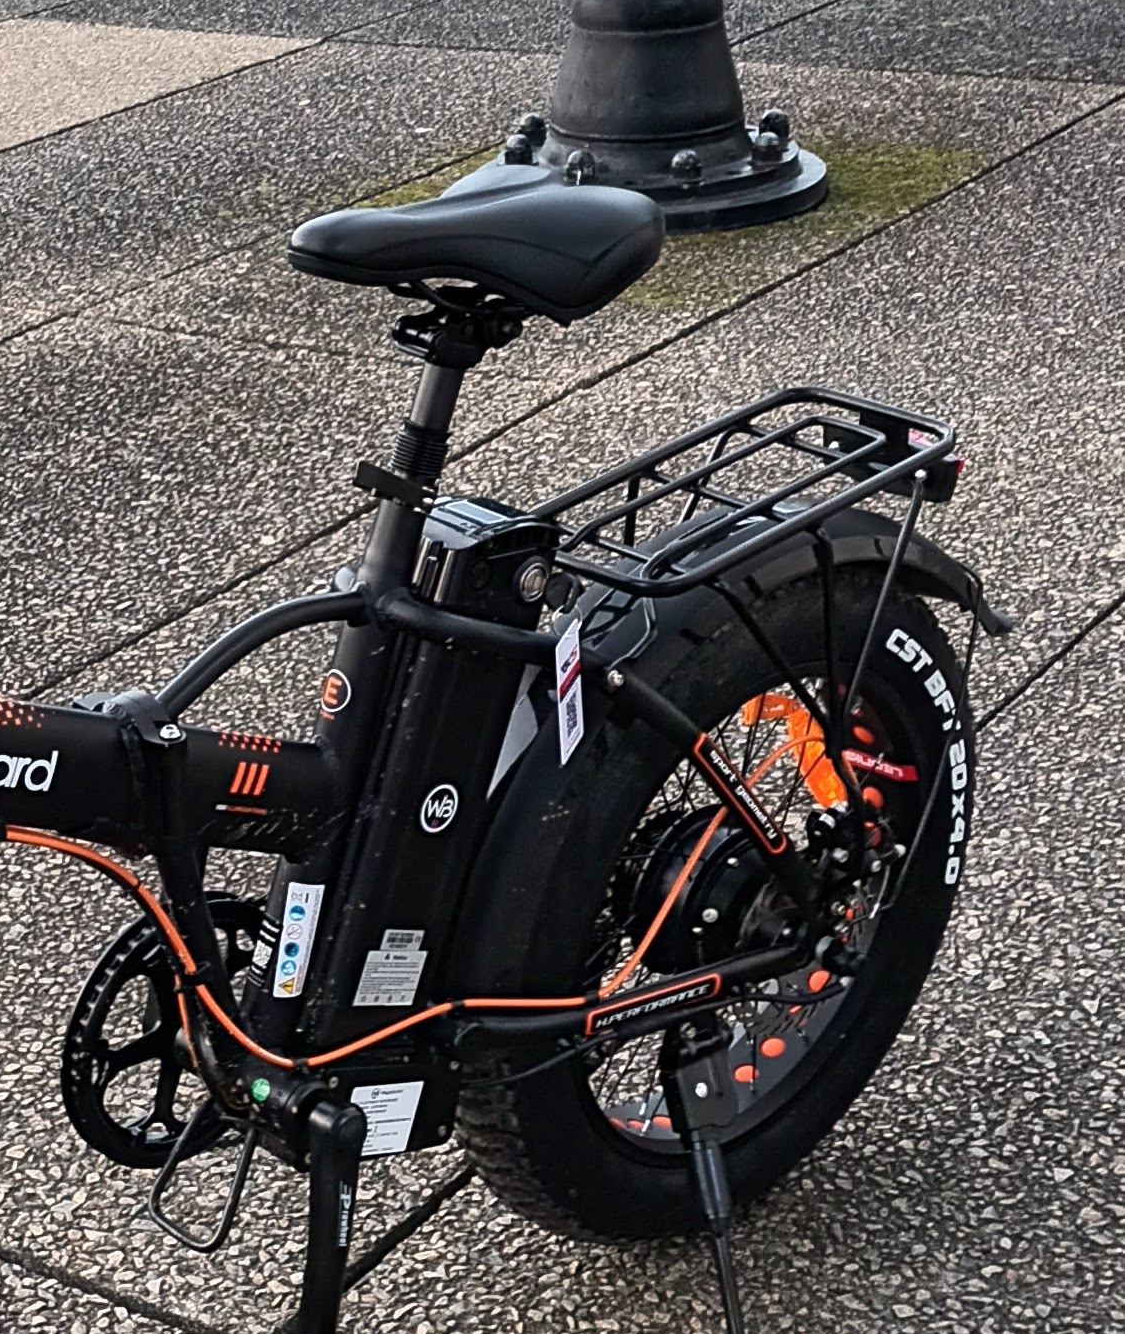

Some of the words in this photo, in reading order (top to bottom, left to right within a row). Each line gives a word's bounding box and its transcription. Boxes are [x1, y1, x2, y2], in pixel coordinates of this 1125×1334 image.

[885, 628, 933, 673] CST
[427, 794, 454, 818] WB
[710, 750, 737, 783] sport
[734, 784, 777, 839] geometry
